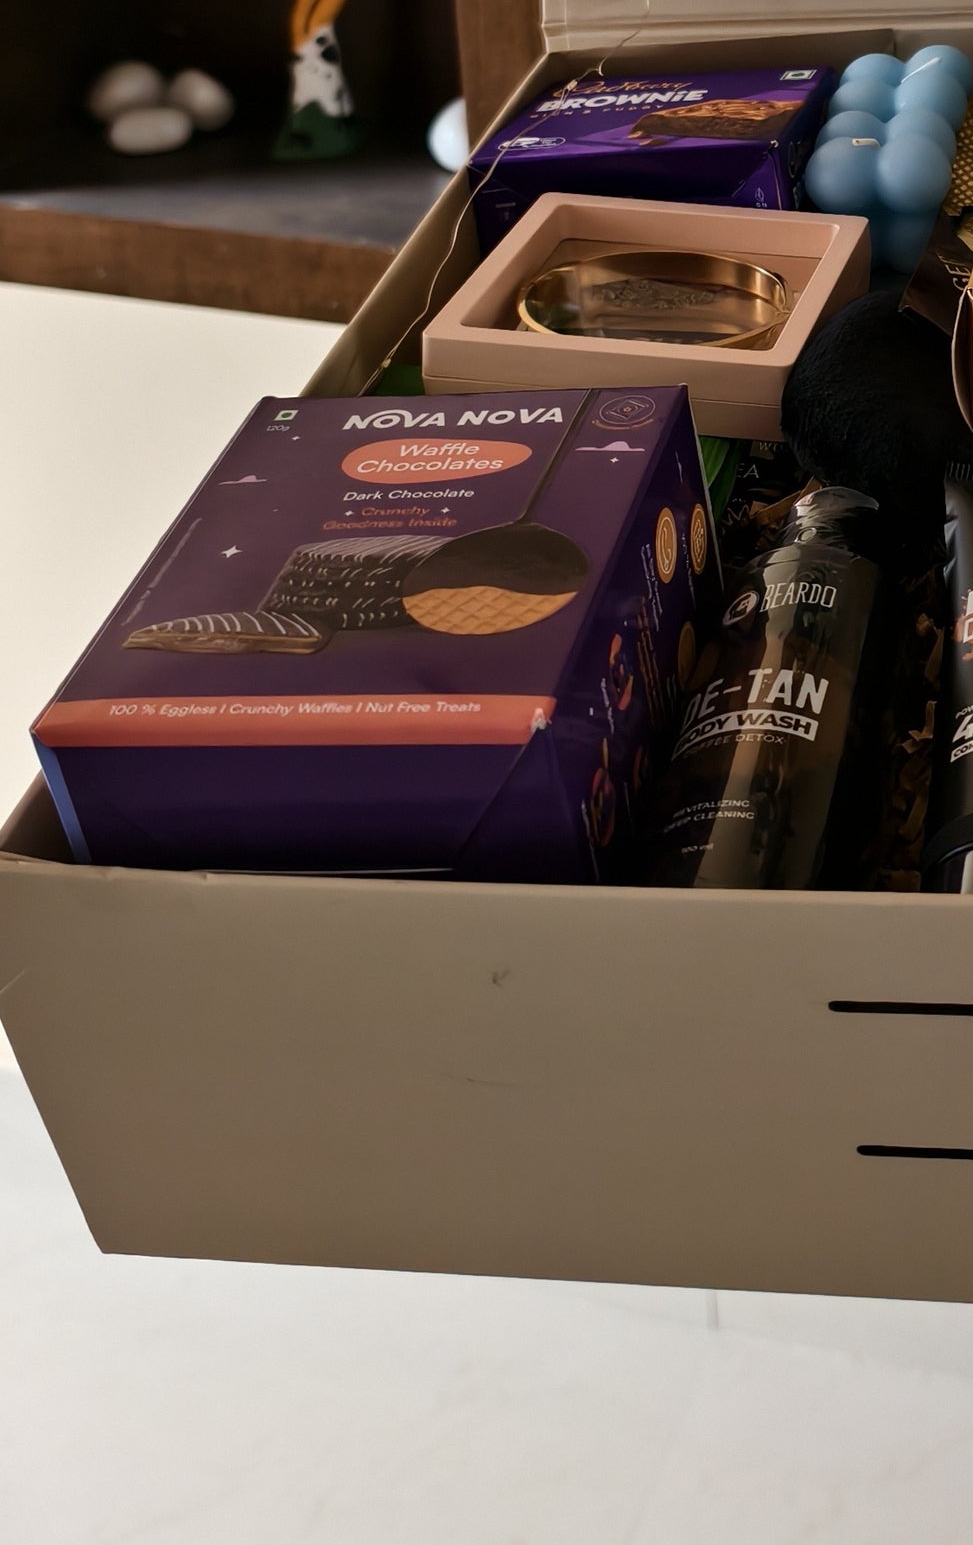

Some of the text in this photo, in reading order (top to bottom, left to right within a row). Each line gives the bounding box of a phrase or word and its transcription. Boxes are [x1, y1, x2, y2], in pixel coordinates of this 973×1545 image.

[342, 407, 564, 430] NOVA NOVA
[399, 442, 480, 457] Waffle
[356, 457, 504, 474] Chocolates
[343, 488, 475, 501] Dark Chocolate
[361, 505, 430, 516] Crunchy
[322, 516, 457, 531] Goodness Inside
[759, 582, 837, 612] BEARDO
[109, 703, 137, 716] 100
[141, 704, 156, 716] %
[159, 704, 216, 717] Eggless
[229, 702, 294, 717] Crunchy
[298, 702, 353, 715] Waffles
[365, 701, 394, 713] Nut
[397, 701, 430, 713] Free
[436, 701, 481, 713] Treats
[681, 667, 829, 736] DE-TAN
[736, 712, 812, 736] WASH
[735, 733, 785, 745] DETOX
